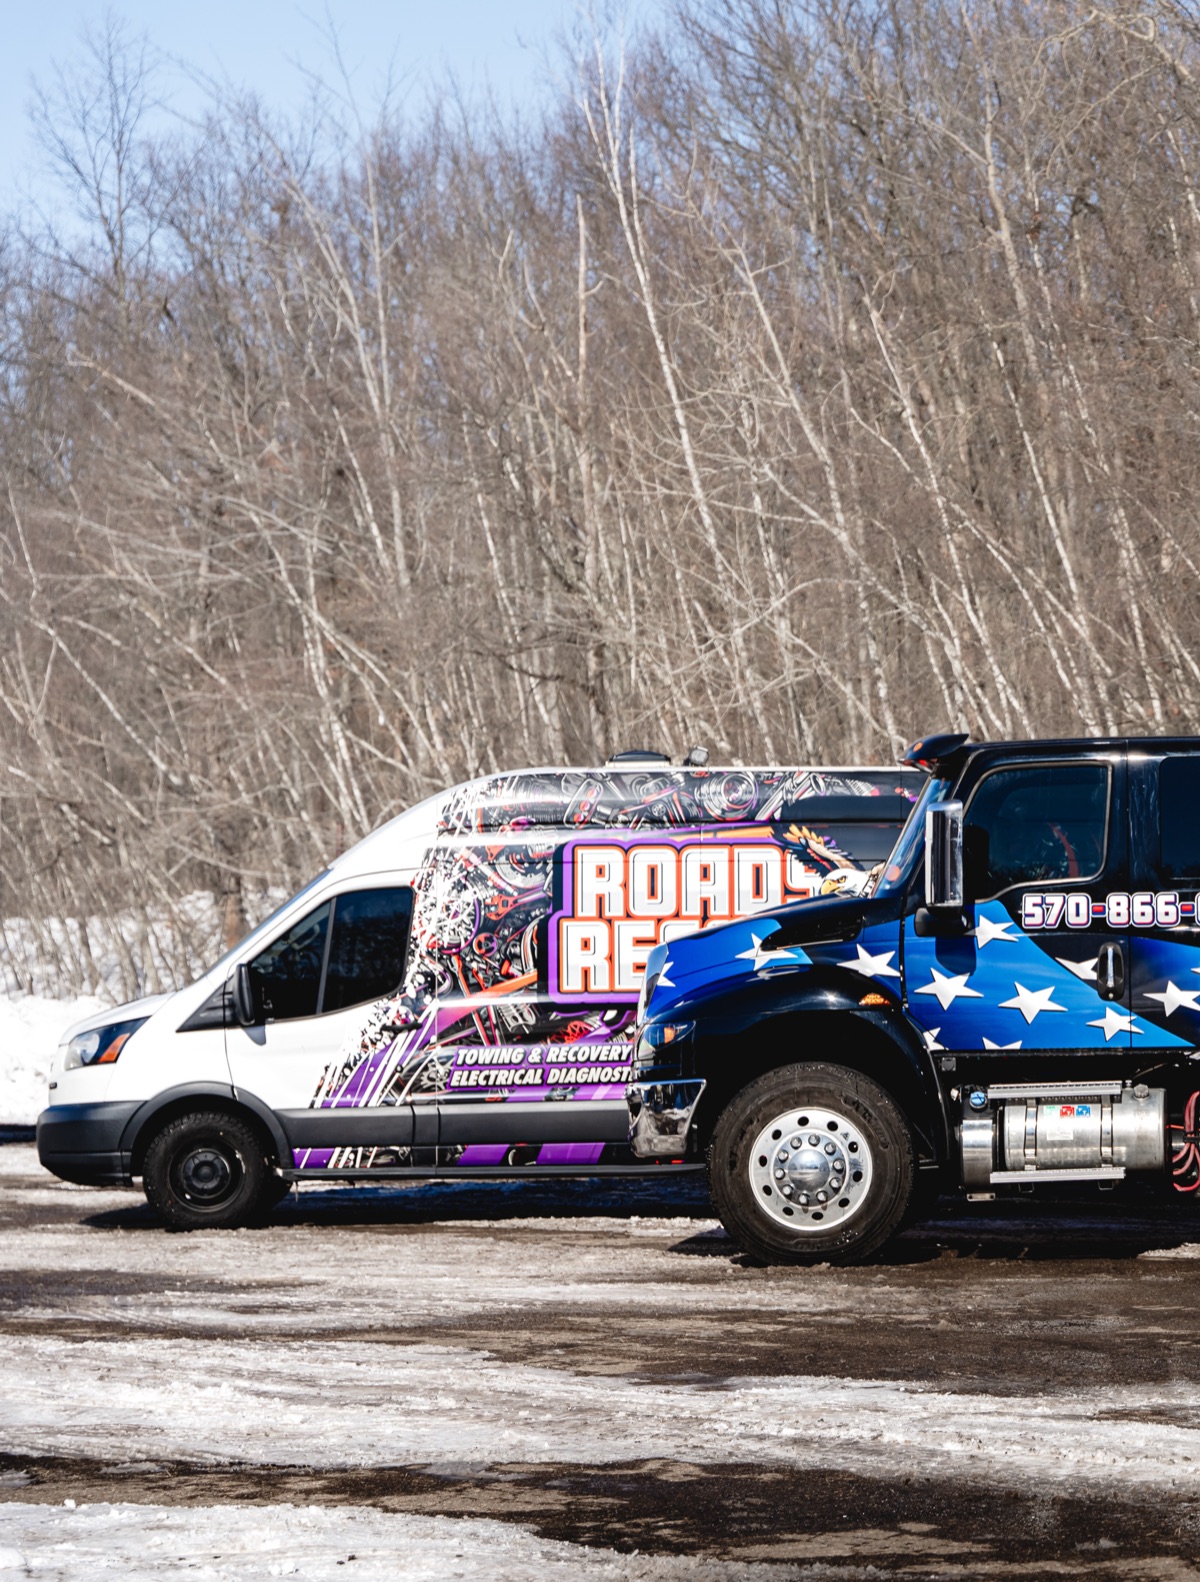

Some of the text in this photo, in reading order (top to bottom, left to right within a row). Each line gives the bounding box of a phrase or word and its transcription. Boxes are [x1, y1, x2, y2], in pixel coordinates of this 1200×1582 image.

[456, 1044, 633, 1066] TOWING & RECOVERY
[450, 1068, 543, 1087] ELECTRICAL
